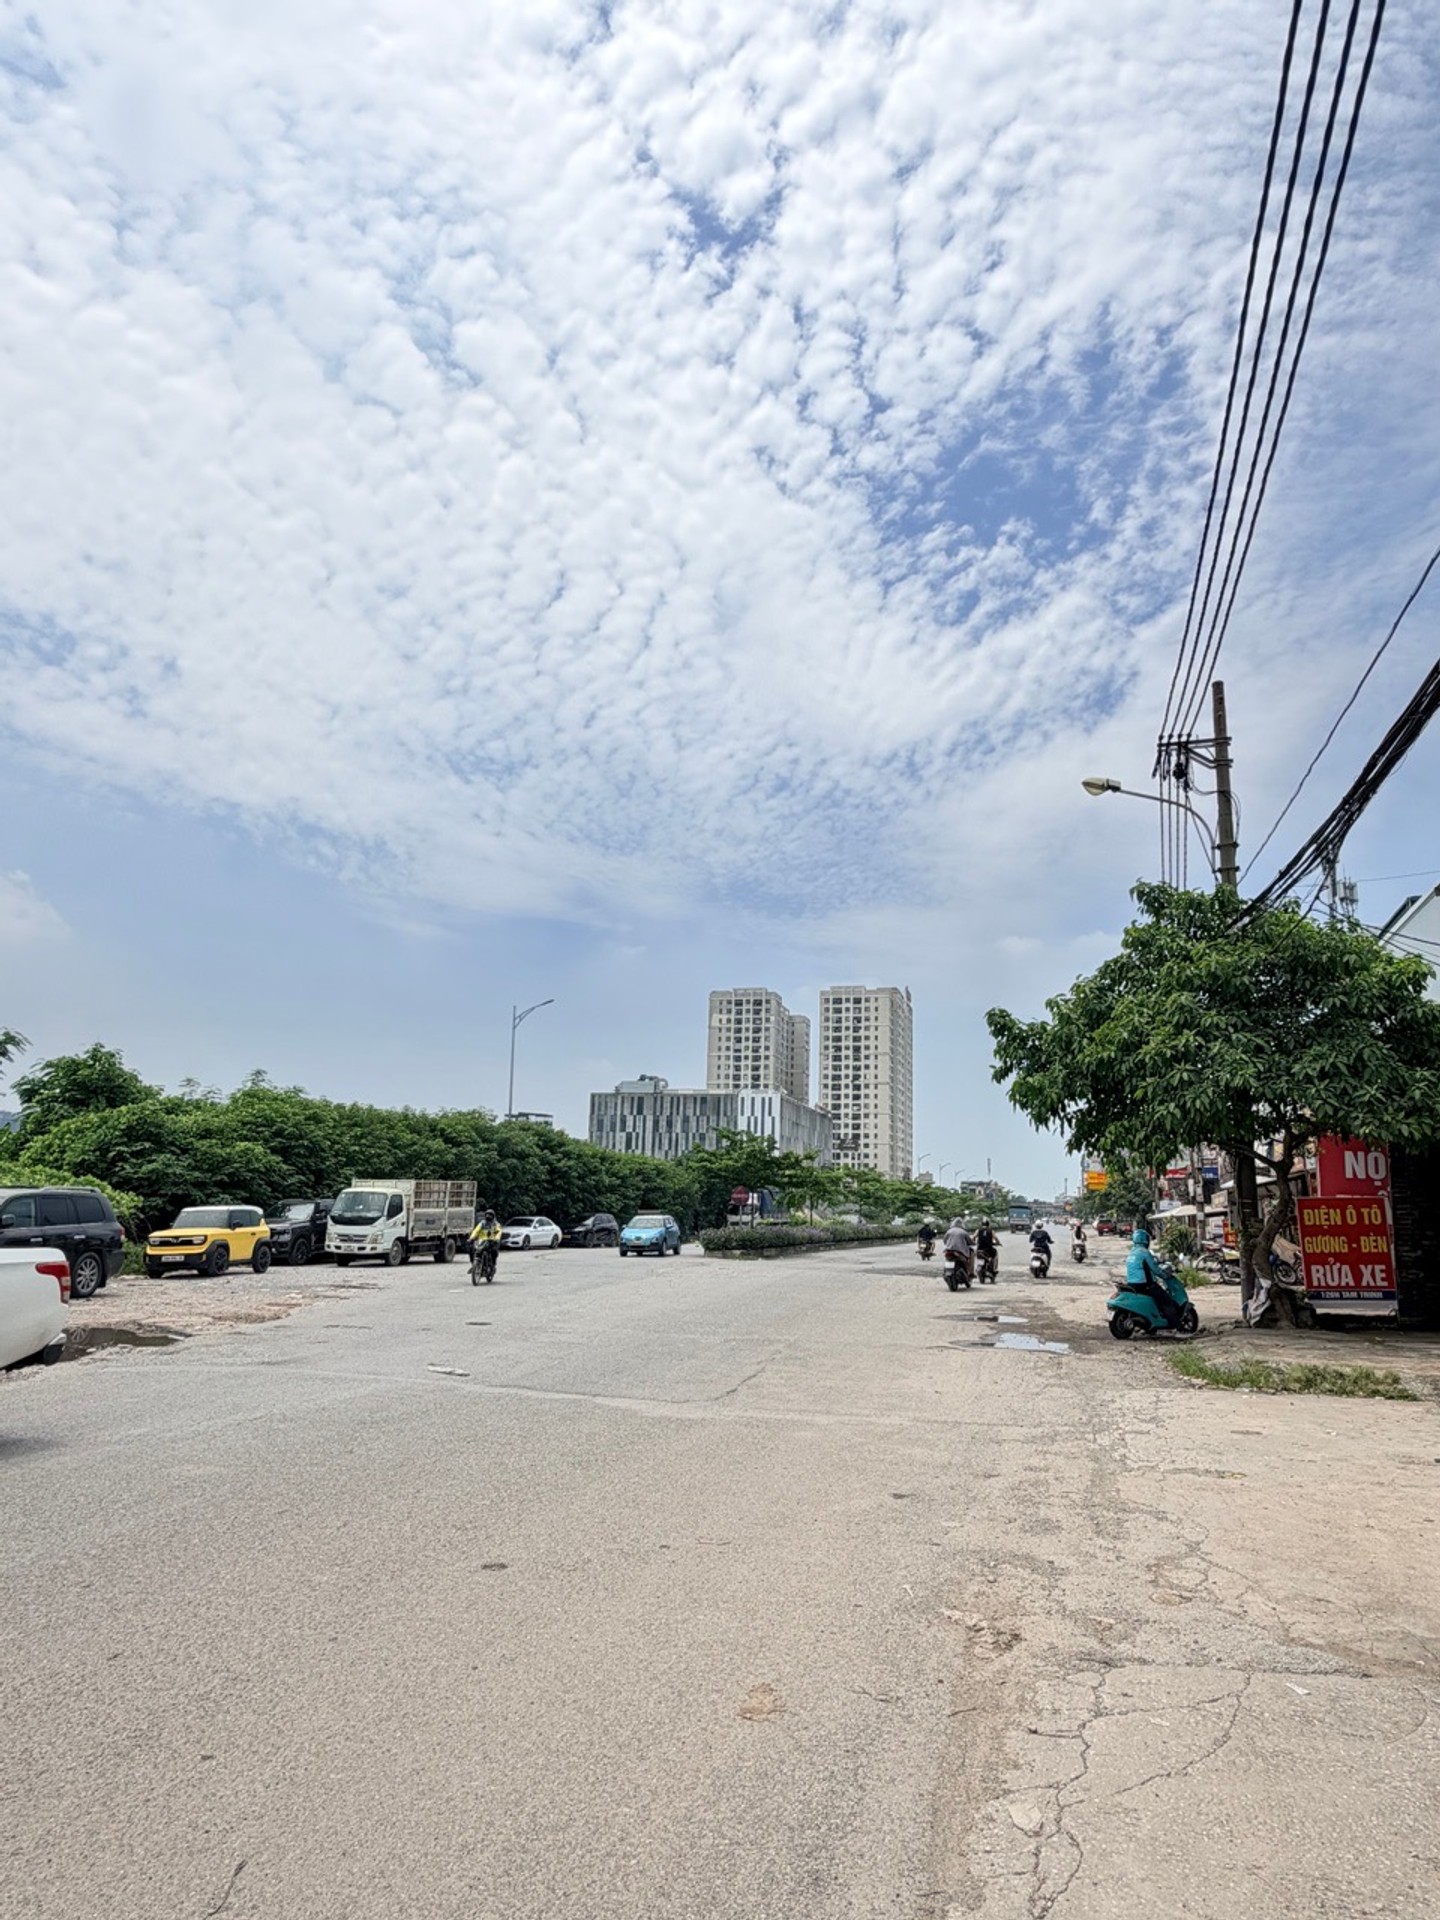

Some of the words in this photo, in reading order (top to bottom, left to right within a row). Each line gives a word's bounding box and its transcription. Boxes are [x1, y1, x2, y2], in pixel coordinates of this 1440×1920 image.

[1303, 1205, 1342, 1229] ĐIỆN
[1346, 1205, 1358, 1225] Ô
[1361, 1205, 1382, 1225] TÔ
[1304, 1235, 1348, 1253] GƯƠNG
[1360, 1233, 1388, 1253] ĐÈN
[1311, 1257, 1355, 1287] RỬA
[1360, 1265, 1389, 1287] XE
